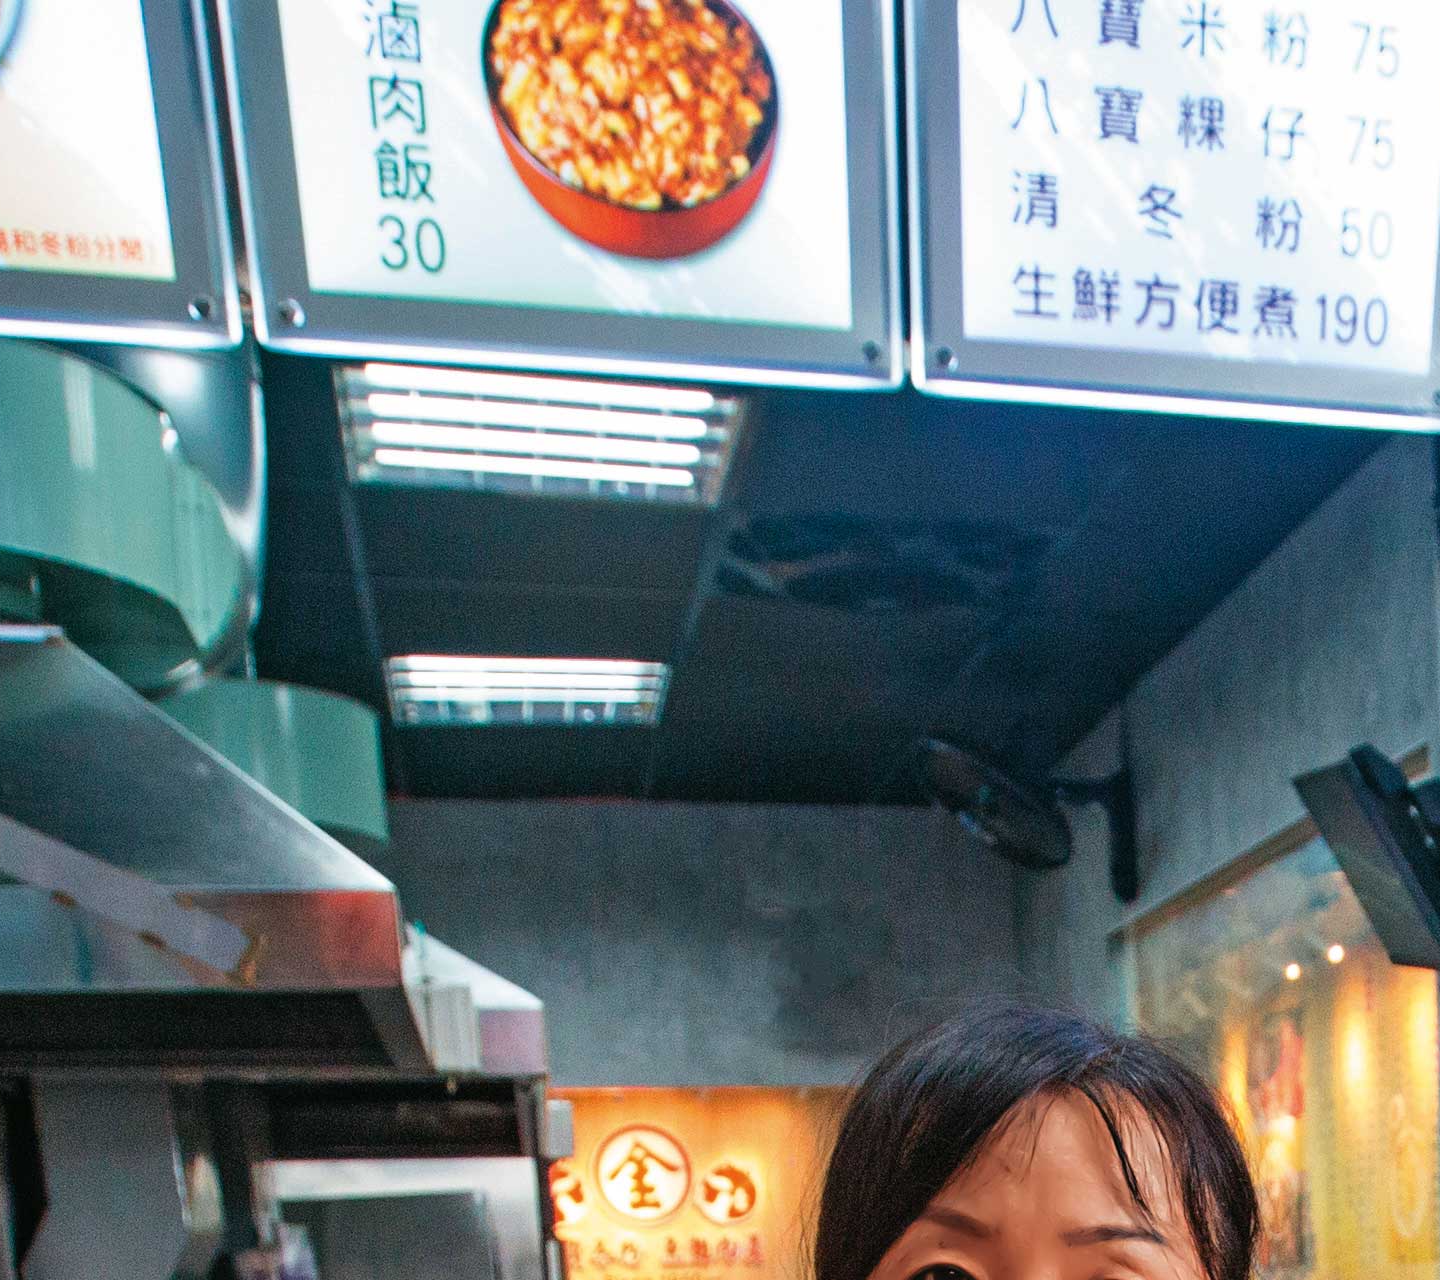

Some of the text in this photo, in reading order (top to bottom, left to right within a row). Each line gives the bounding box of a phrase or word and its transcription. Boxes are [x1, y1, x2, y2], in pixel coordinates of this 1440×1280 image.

[1350, 21, 1400, 78] 75
[1347, 116, 1396, 171] 75
[379, 215, 447, 273] 30
[1340, 208, 1394, 261] 50
[1315, 293, 1390, 347] 190
